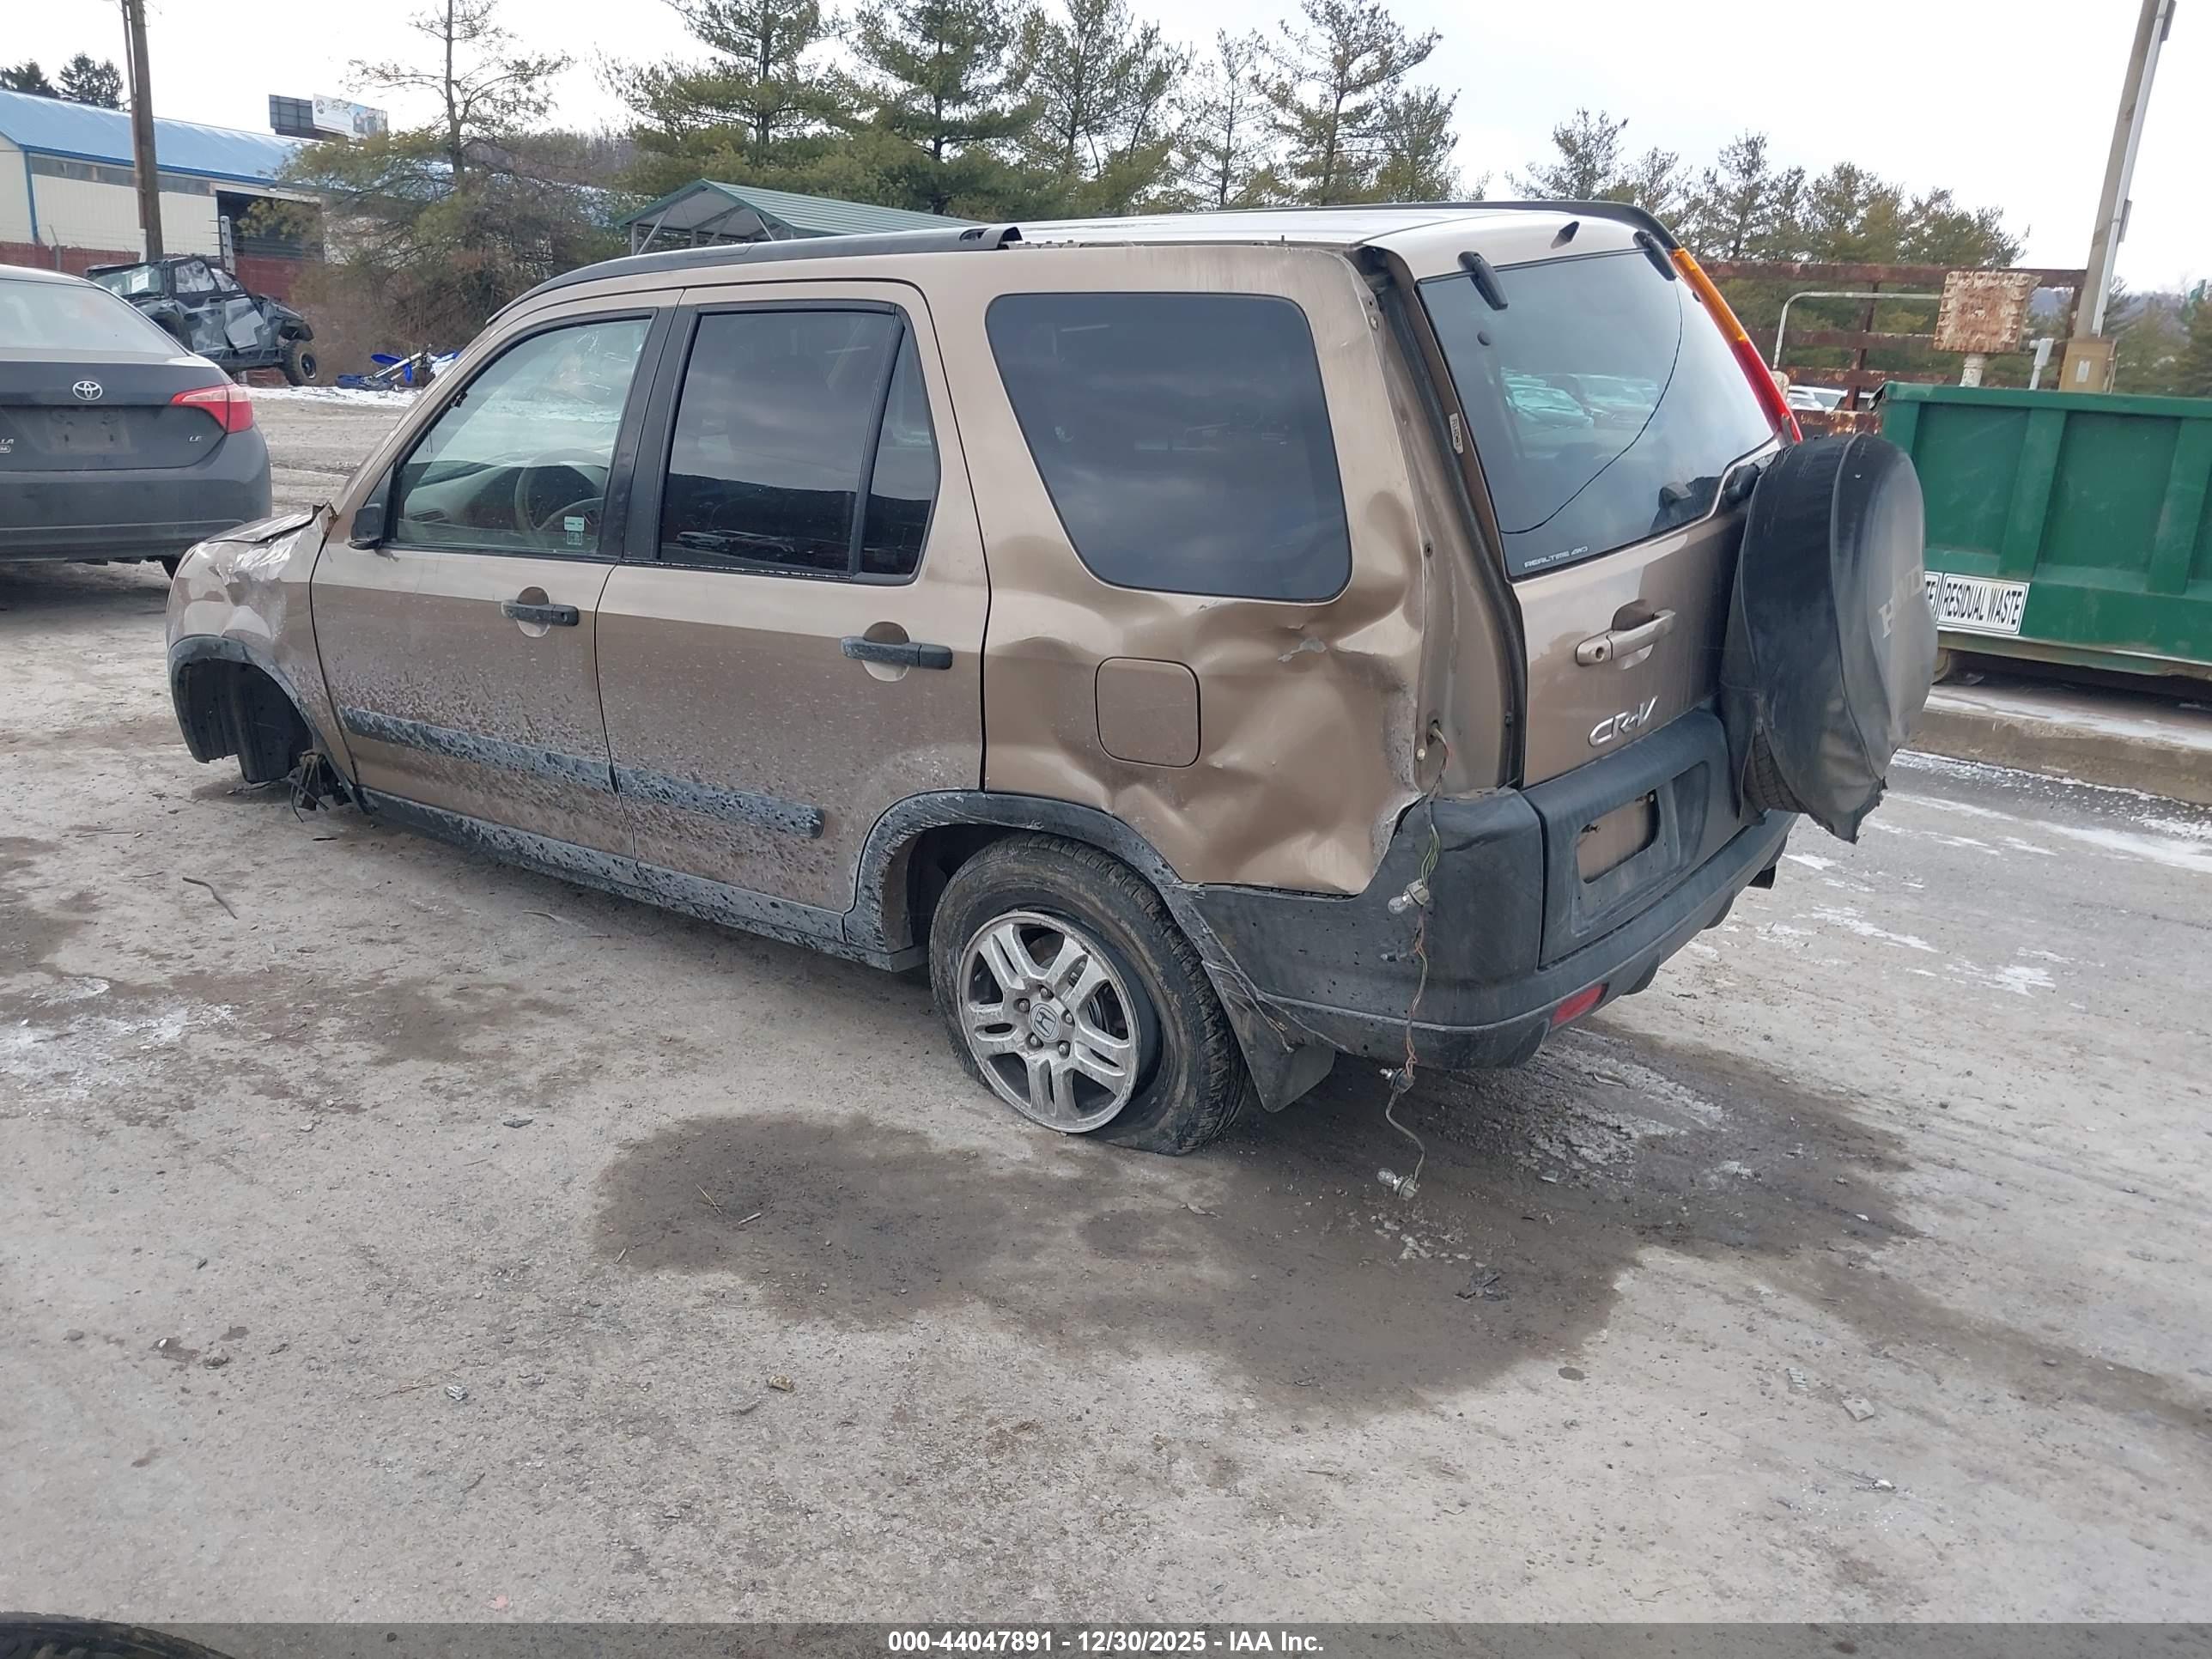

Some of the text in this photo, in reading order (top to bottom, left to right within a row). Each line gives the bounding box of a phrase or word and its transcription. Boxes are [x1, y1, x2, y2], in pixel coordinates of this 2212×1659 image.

[1940, 582, 1987, 621] RESIDUAL
[1986, 586, 2023, 626] WASTE
[1588, 695, 1658, 747] CR-V
